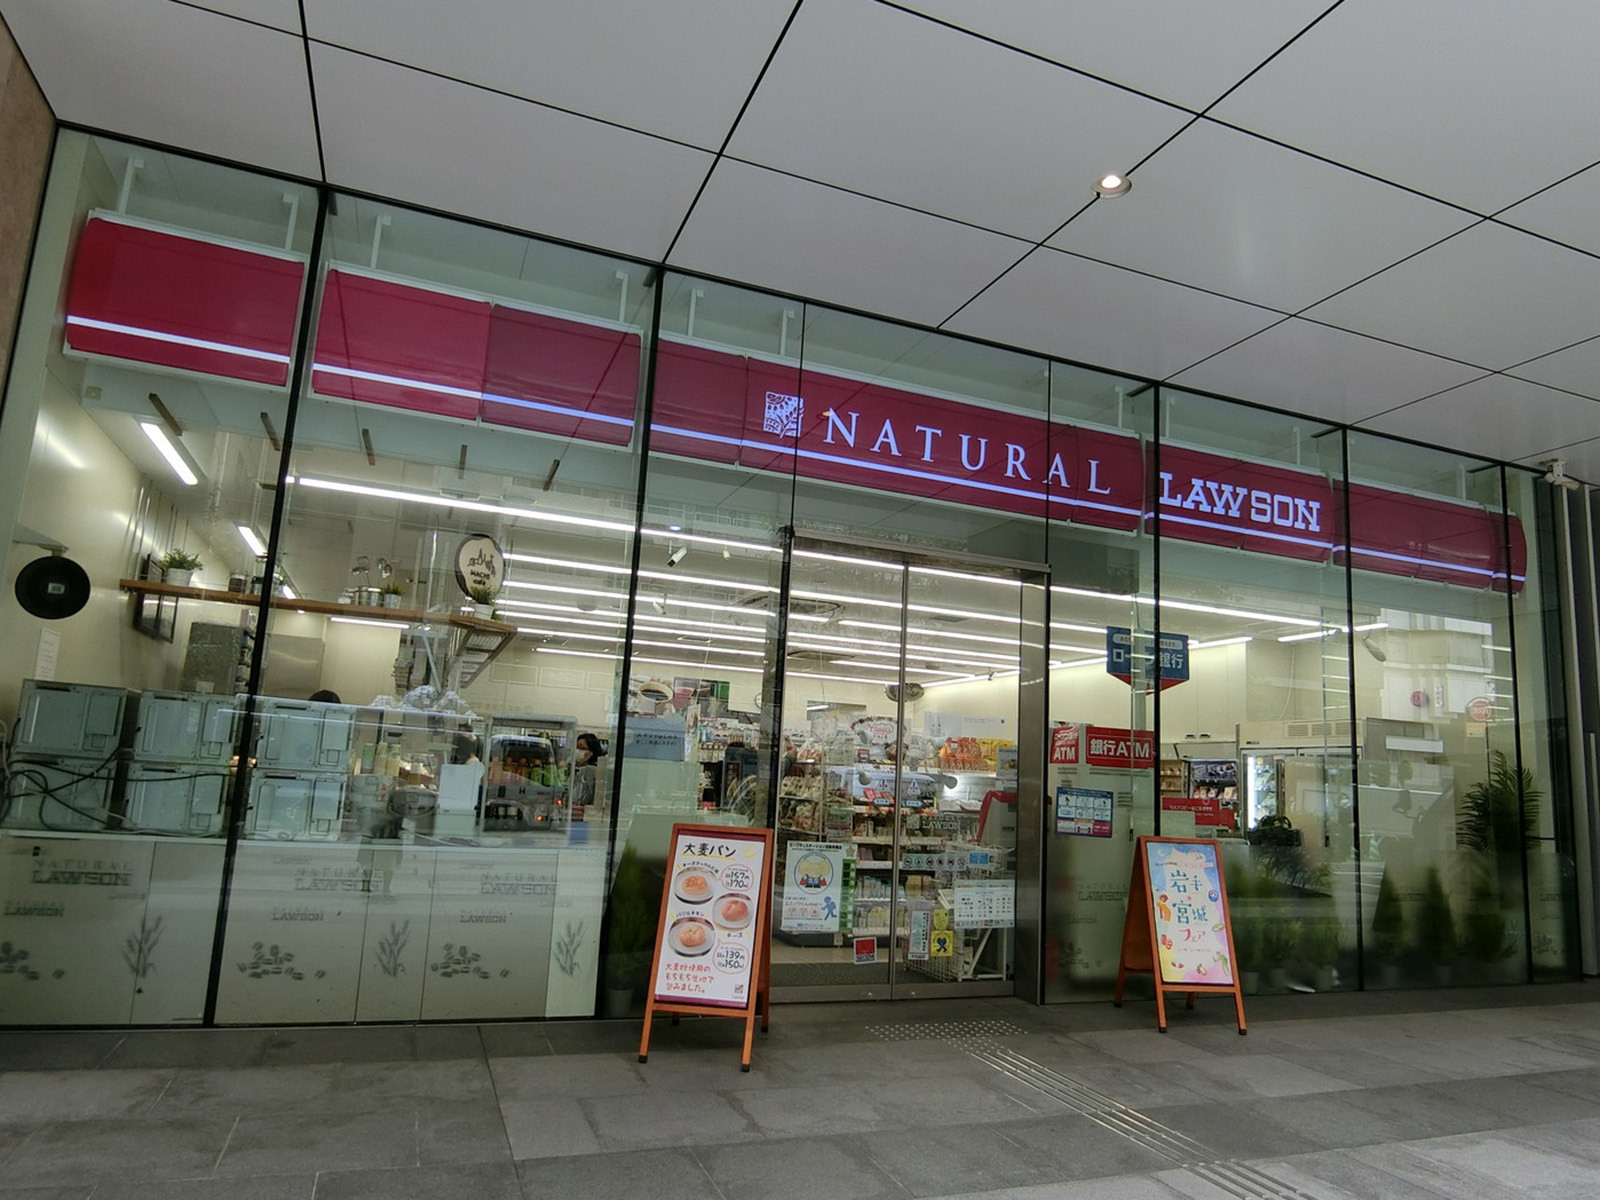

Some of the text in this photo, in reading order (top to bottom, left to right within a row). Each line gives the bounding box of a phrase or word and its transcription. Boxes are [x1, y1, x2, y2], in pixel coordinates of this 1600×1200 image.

[823, 407, 1321, 532] NATURAL LAWSON
[1053, 747, 1075, 760] ATM
[922, 821, 960, 830] LAWSON
[683, 842, 736, 857] 大麦パン
[31, 870, 132, 886] LAWSON
[1170, 869, 1203, 893] 岩手
[295, 879, 382, 893] LAWSON
[480, 883, 555, 895] LAWSON
[272, 913, 324, 921] LAWSON
[460, 915, 507, 923] LAWSON
[1172, 900, 1208, 925] 宮城
[1178, 928, 1206, 942] フェア
